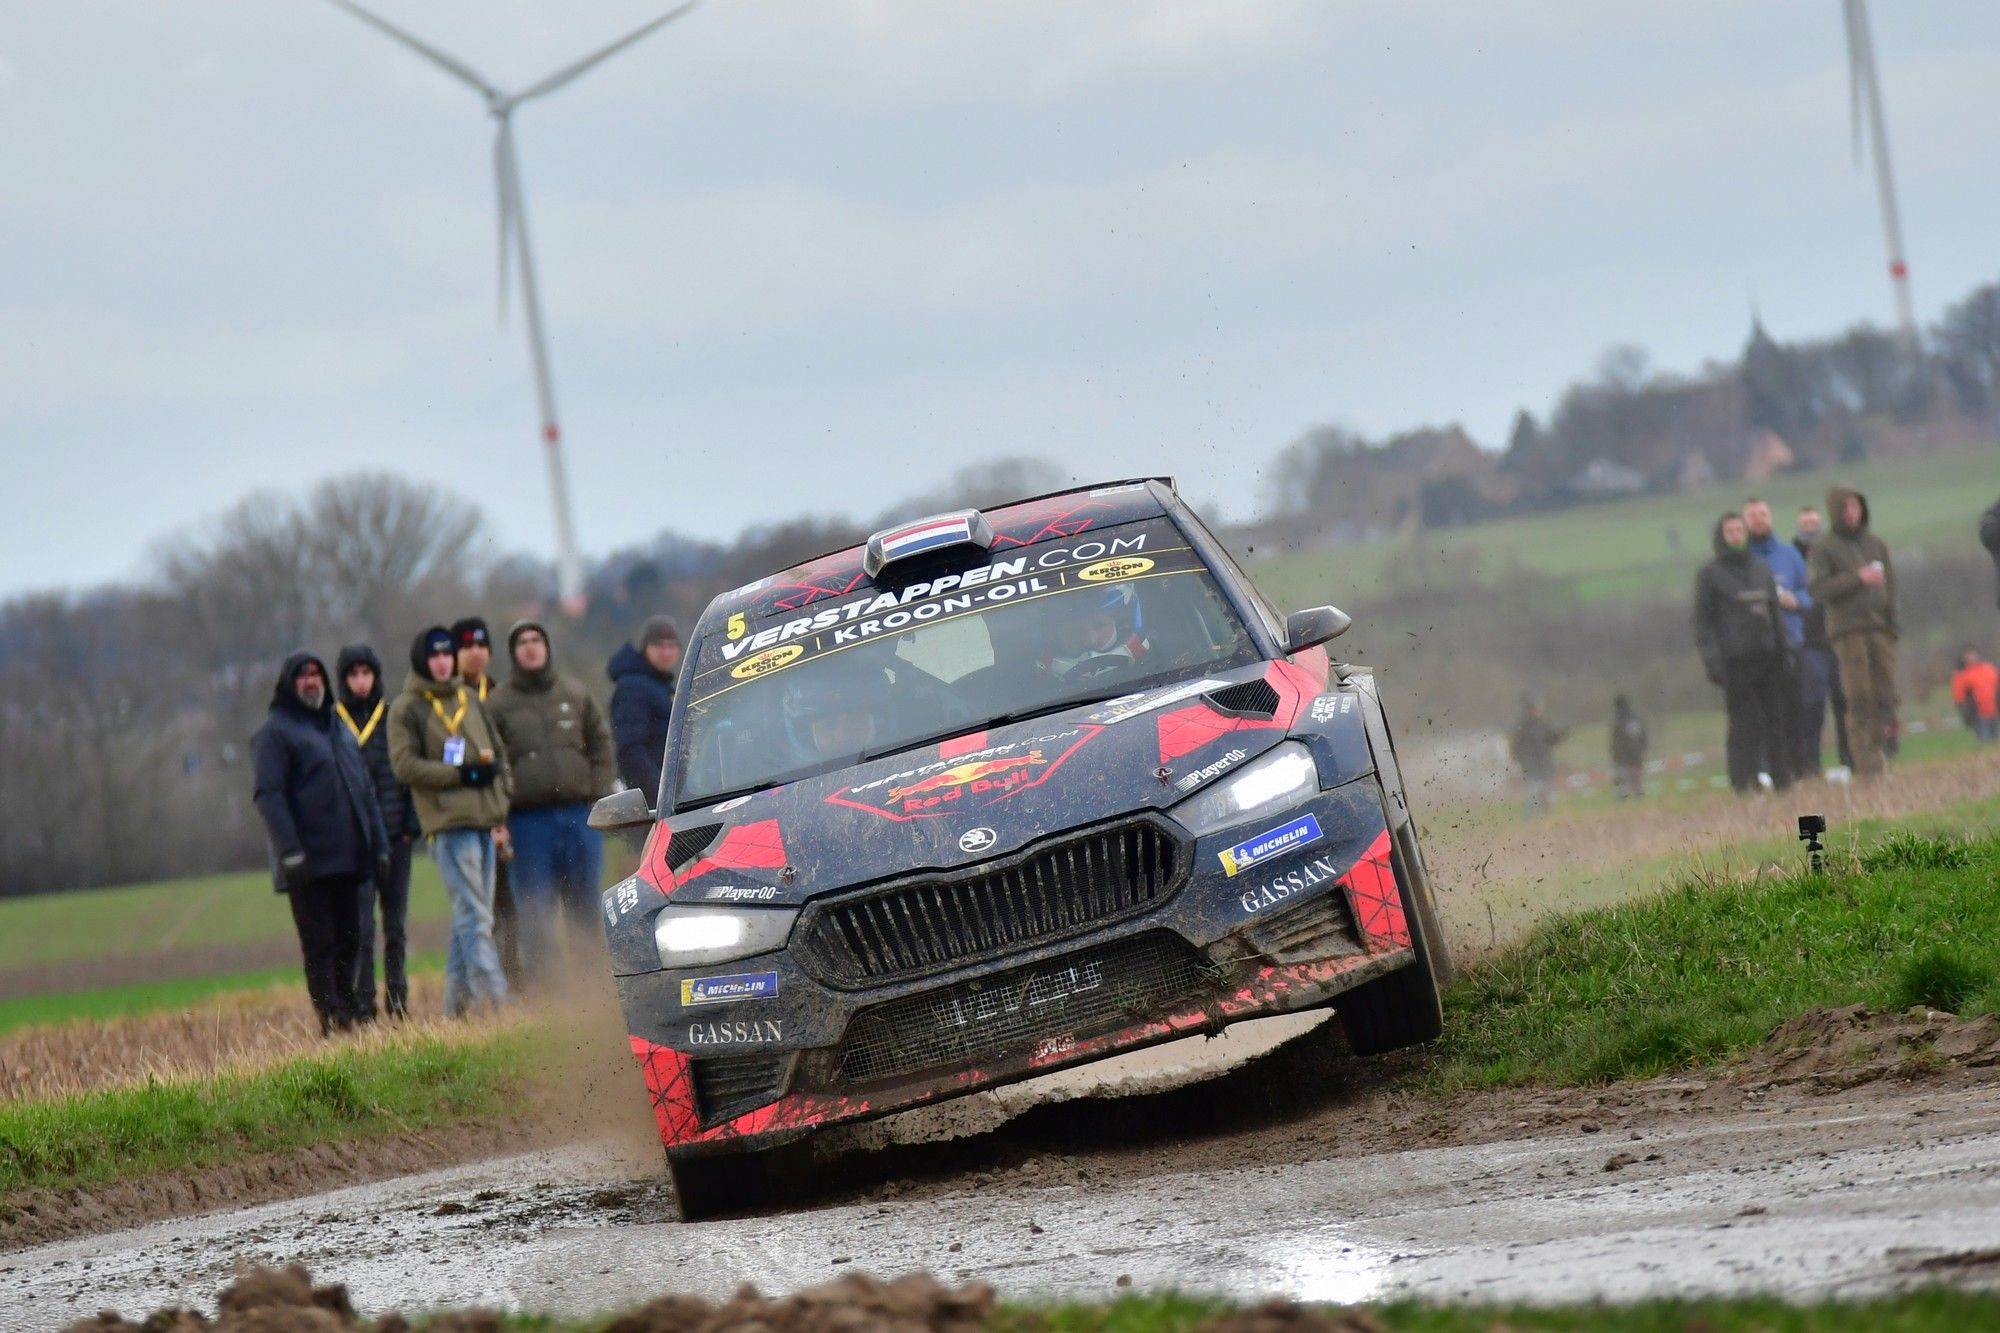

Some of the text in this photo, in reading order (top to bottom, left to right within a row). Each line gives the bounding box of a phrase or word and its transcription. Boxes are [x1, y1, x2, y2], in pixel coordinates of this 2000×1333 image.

[1088, 562, 1144, 576] KROON
[1104, 569, 1129, 579] OIL
[721, 533, 1147, 660] VERSTAPPEN.COM
[834, 577, 1048, 644] KROON-OIL
[727, 612, 746, 640] 5
[740, 650, 793, 674] KROON
[755, 660, 779, 673] OIL
[902, 769, 1029, 814] Red Bull
[1252, 825, 1309, 857] MICHELIN
[717, 886, 760, 901] Player
[1241, 856, 1337, 913] GASSAN
[689, 1020, 783, 1045] GASSAN
